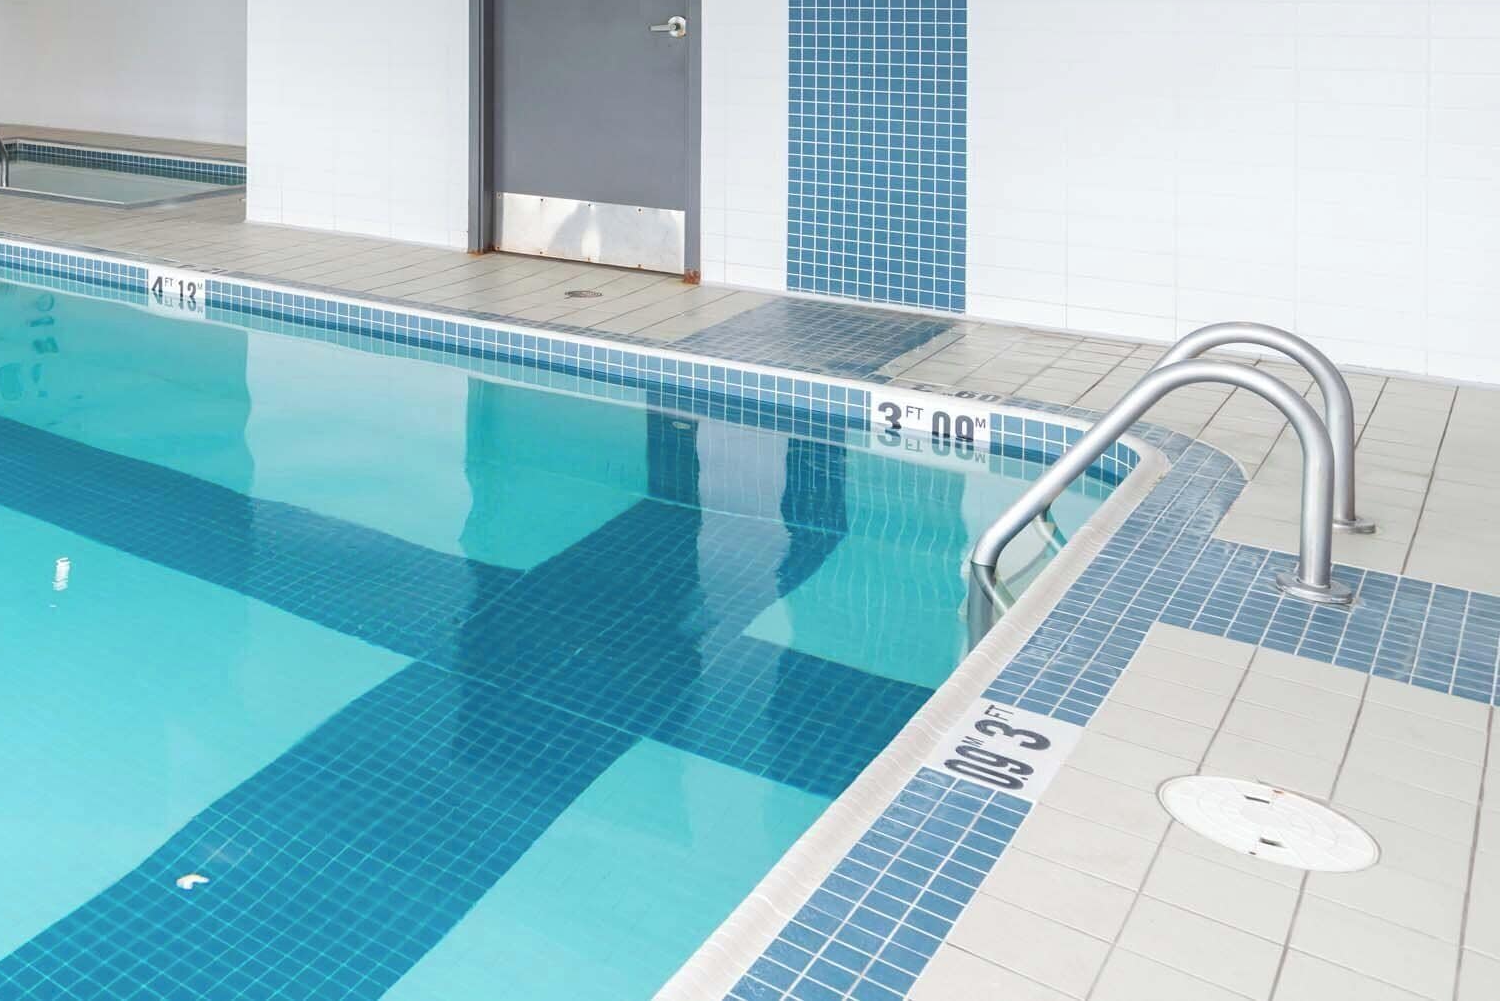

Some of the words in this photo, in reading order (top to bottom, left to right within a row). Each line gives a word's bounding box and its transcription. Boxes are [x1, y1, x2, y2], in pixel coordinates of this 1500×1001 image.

[906, 405, 924, 421] FT
[984, 703, 1015, 721] FT
[974, 718, 1052, 751] 3
